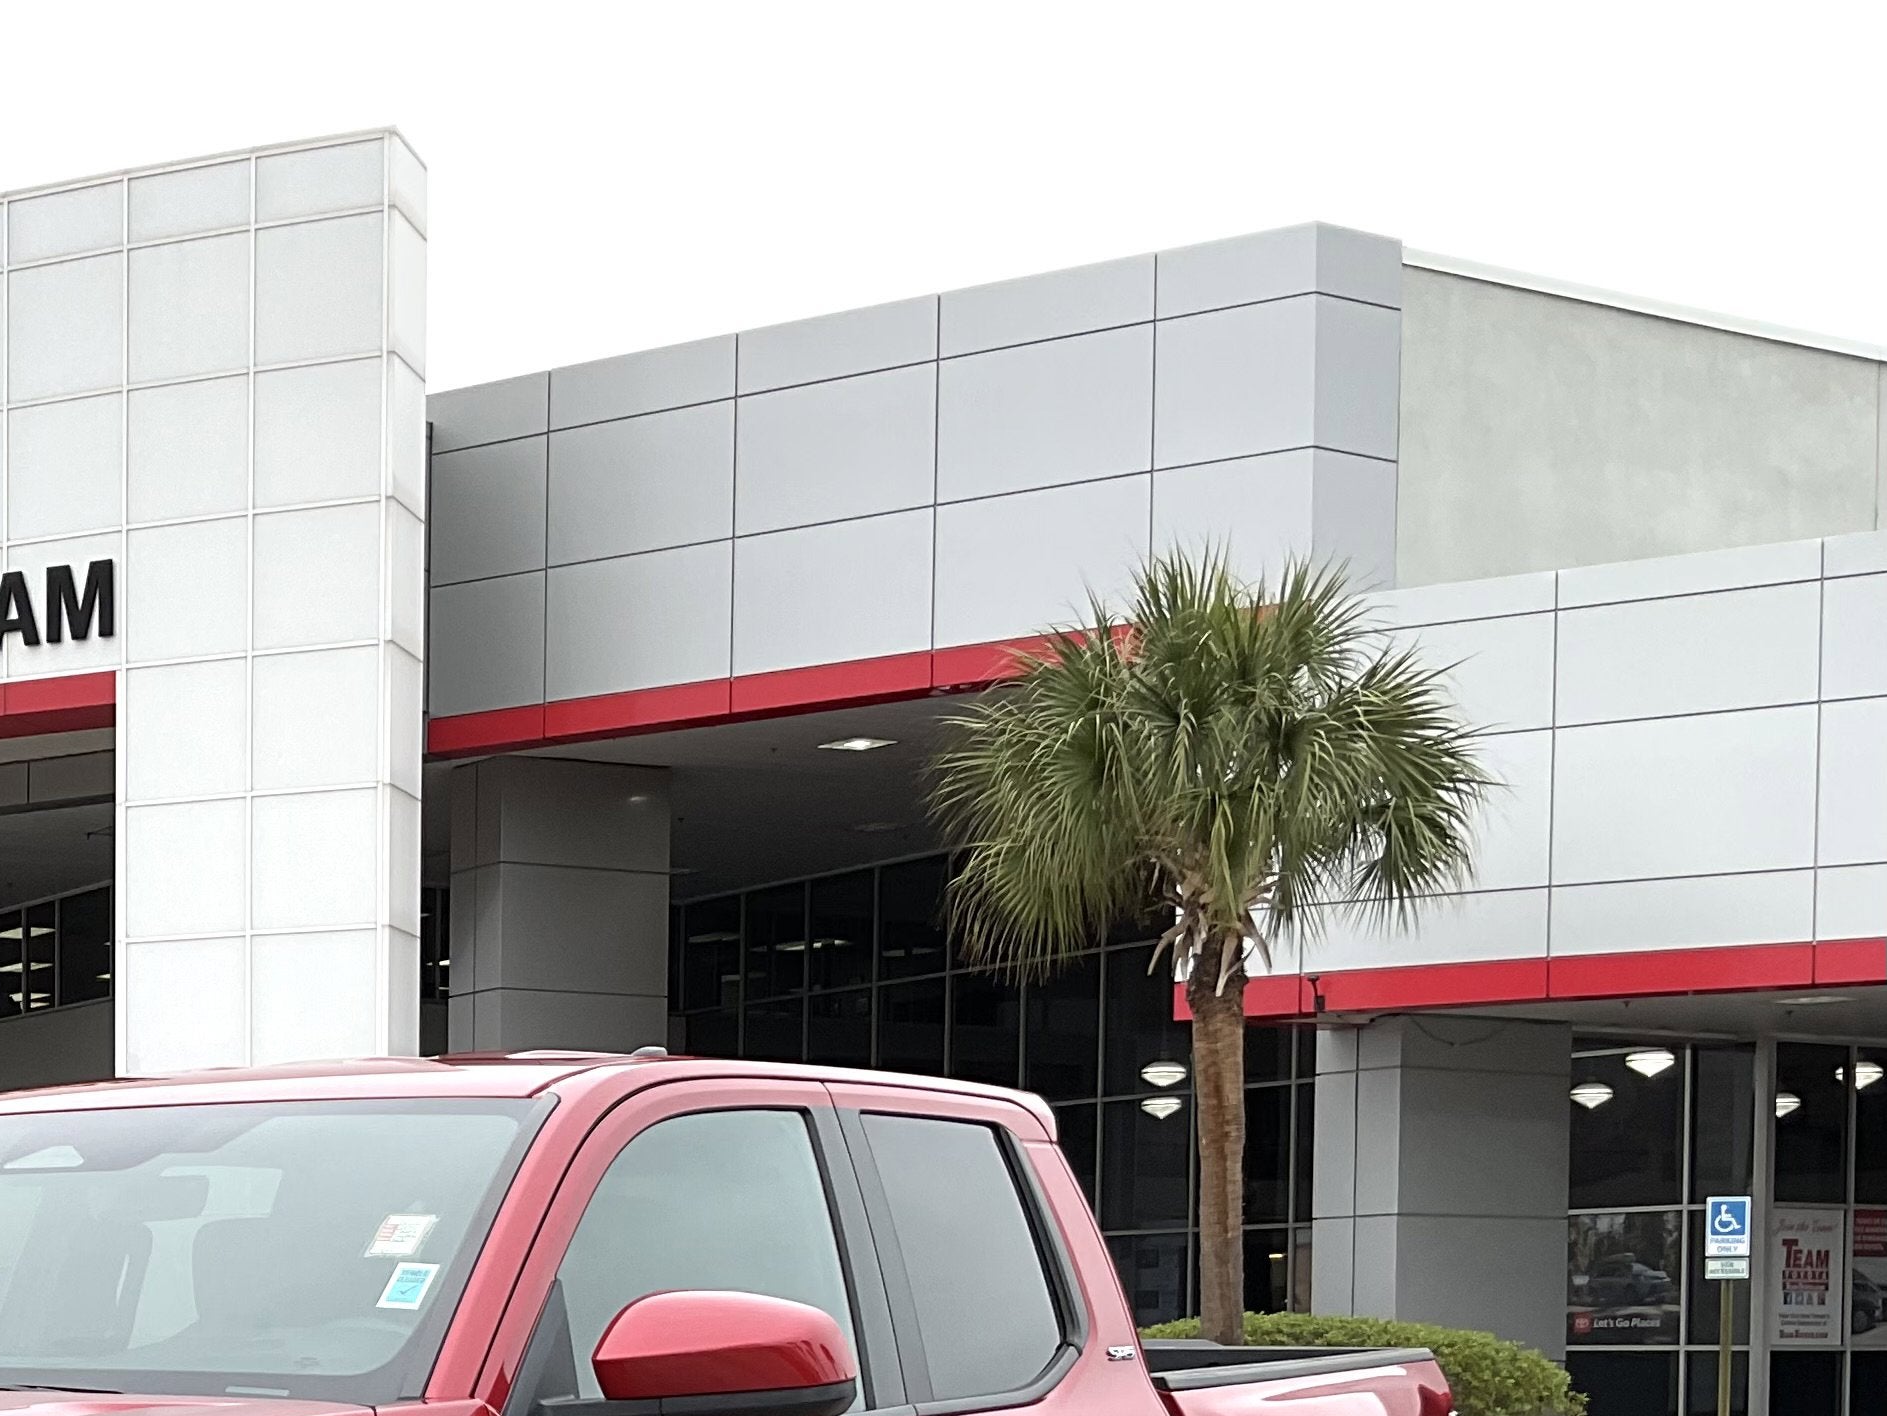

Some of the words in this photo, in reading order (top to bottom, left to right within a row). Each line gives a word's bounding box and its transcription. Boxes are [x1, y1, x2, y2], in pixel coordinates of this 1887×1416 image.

[1716, 1245, 1738, 1253] ONLY
[1782, 1238, 1830, 1269] TEAM
[1593, 1317, 1614, 1328] Let's
[1615, 1318, 1630, 1328] Go
[1631, 1317, 1661, 1328] Places
